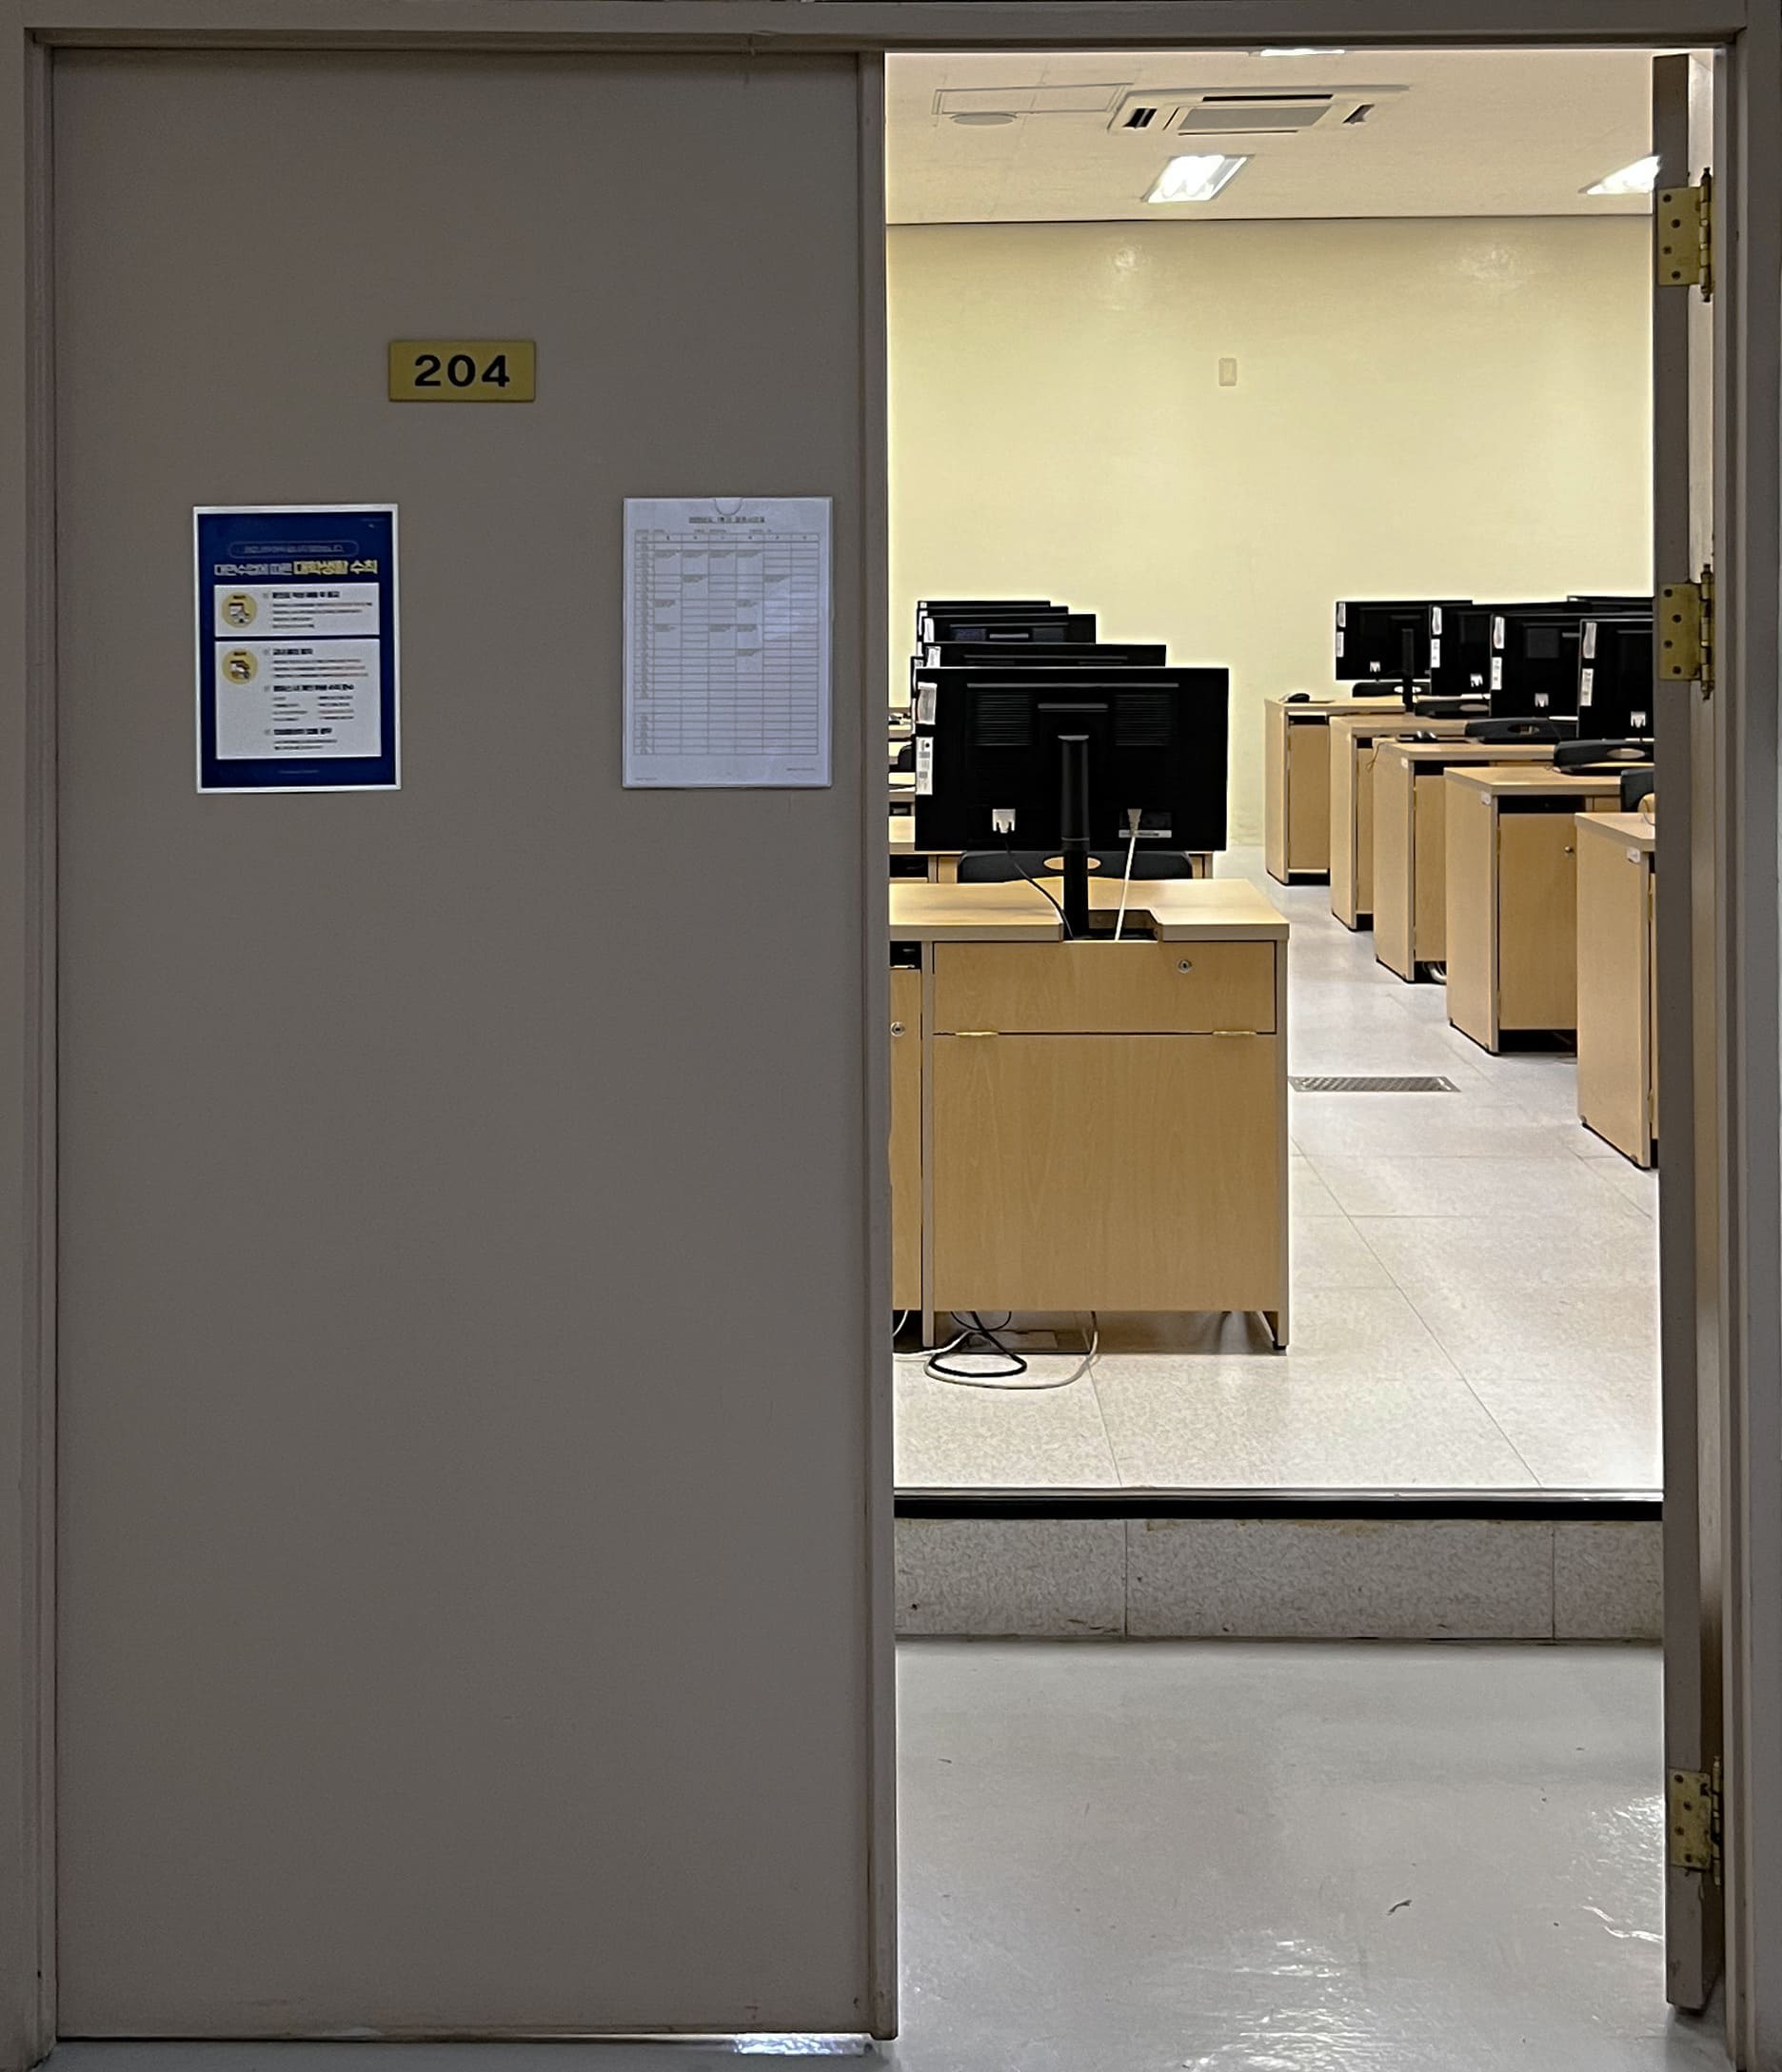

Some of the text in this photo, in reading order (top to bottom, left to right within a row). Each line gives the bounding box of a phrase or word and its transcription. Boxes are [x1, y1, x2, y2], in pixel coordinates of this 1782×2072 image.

[414, 354, 510, 387] 204
[293, 561, 347, 575] 대학생활
[349, 560, 378, 574] 수칙
